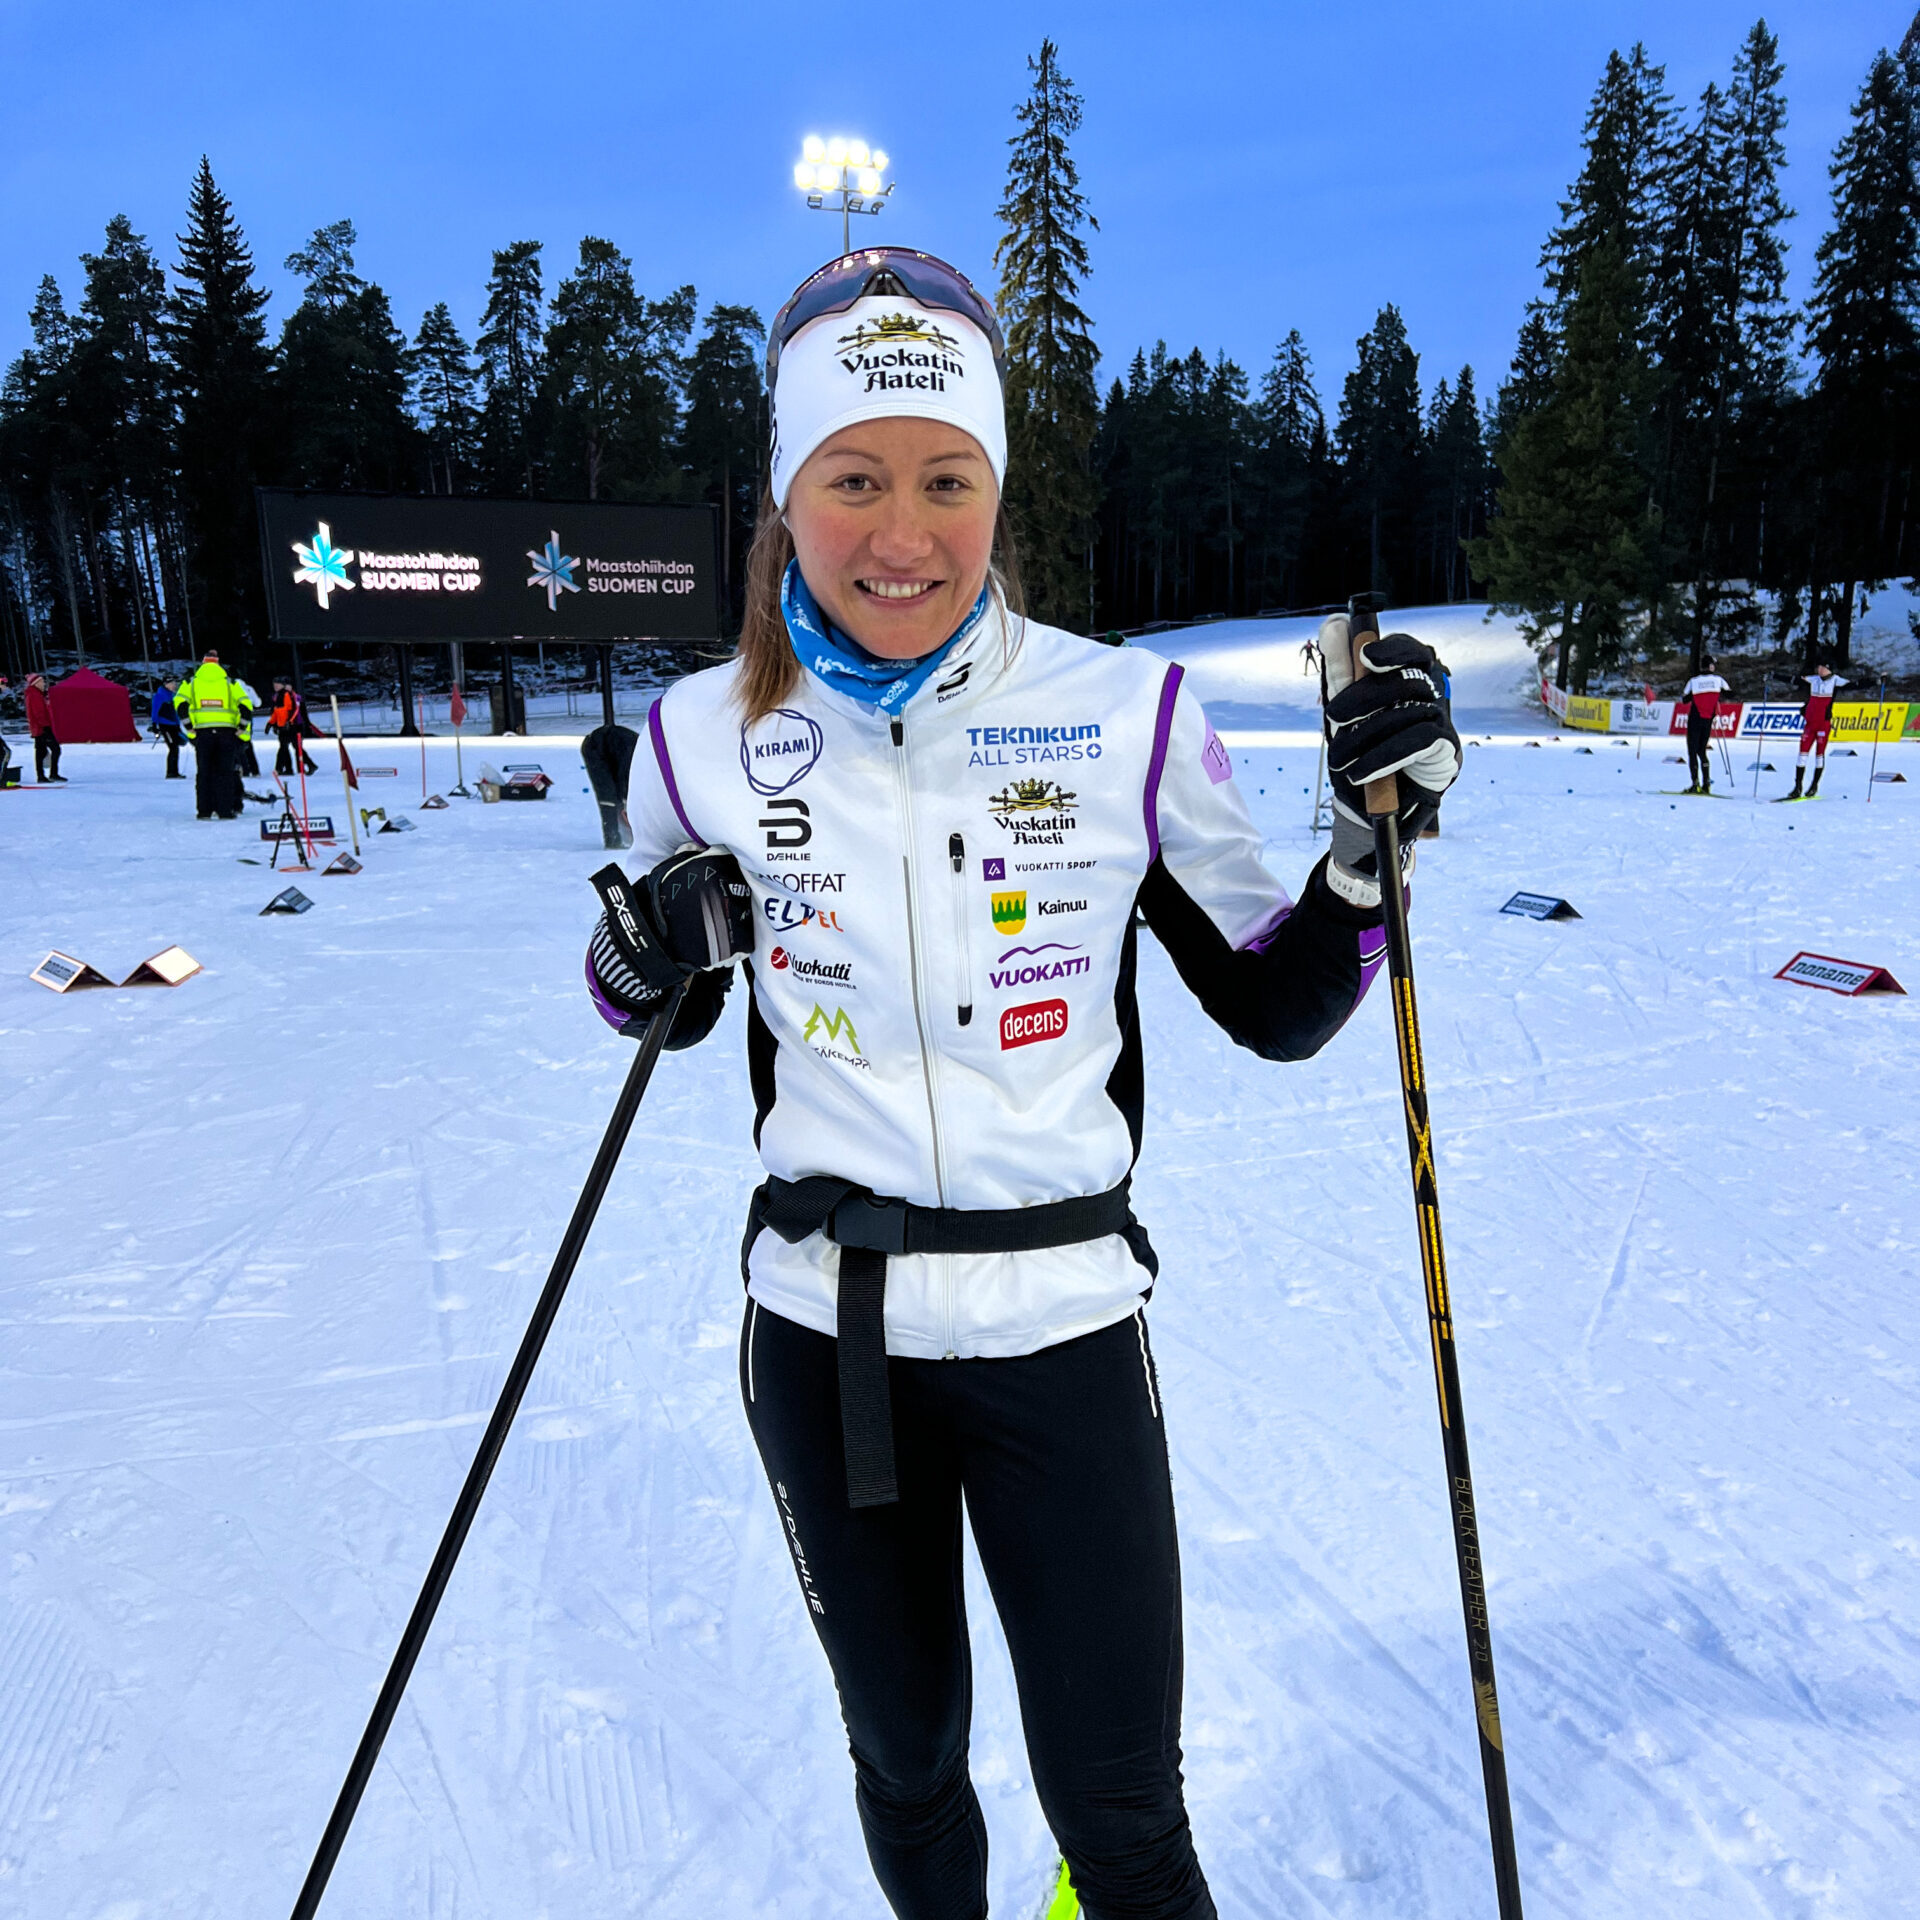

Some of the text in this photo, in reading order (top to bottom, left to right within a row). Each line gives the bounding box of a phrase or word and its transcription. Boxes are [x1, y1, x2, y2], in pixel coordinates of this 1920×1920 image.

[841, 348, 964, 378] Vuokatin
[863, 370, 945, 393] Aateli
[358, 550, 480, 571] Maastohiihdon
[586, 557, 694, 576] Maastohiihdon
[361, 572, 481, 592] SUOMEN CUP
[587, 577, 696, 595] SUOMEN CUP
[1831, 707, 1880, 738] qualan
[966, 723, 1101, 747] TEKNIKUM
[755, 737, 810, 759] KIRAMI
[968, 744, 1084, 768] ALL STARS
[994, 814, 1076, 831] Vuokatin
[1013, 831, 1064, 845] Aateli
[1015, 860, 1098, 872] VUOKATTI SPORT
[1038, 899, 1088, 916] Kainuu
[989, 956, 1091, 989] VUOKATTI
[1790, 961, 1866, 986] noname
[1004, 1008, 1064, 1041] decens
[1454, 1476, 1489, 1663] BLACK FEATHER 20
